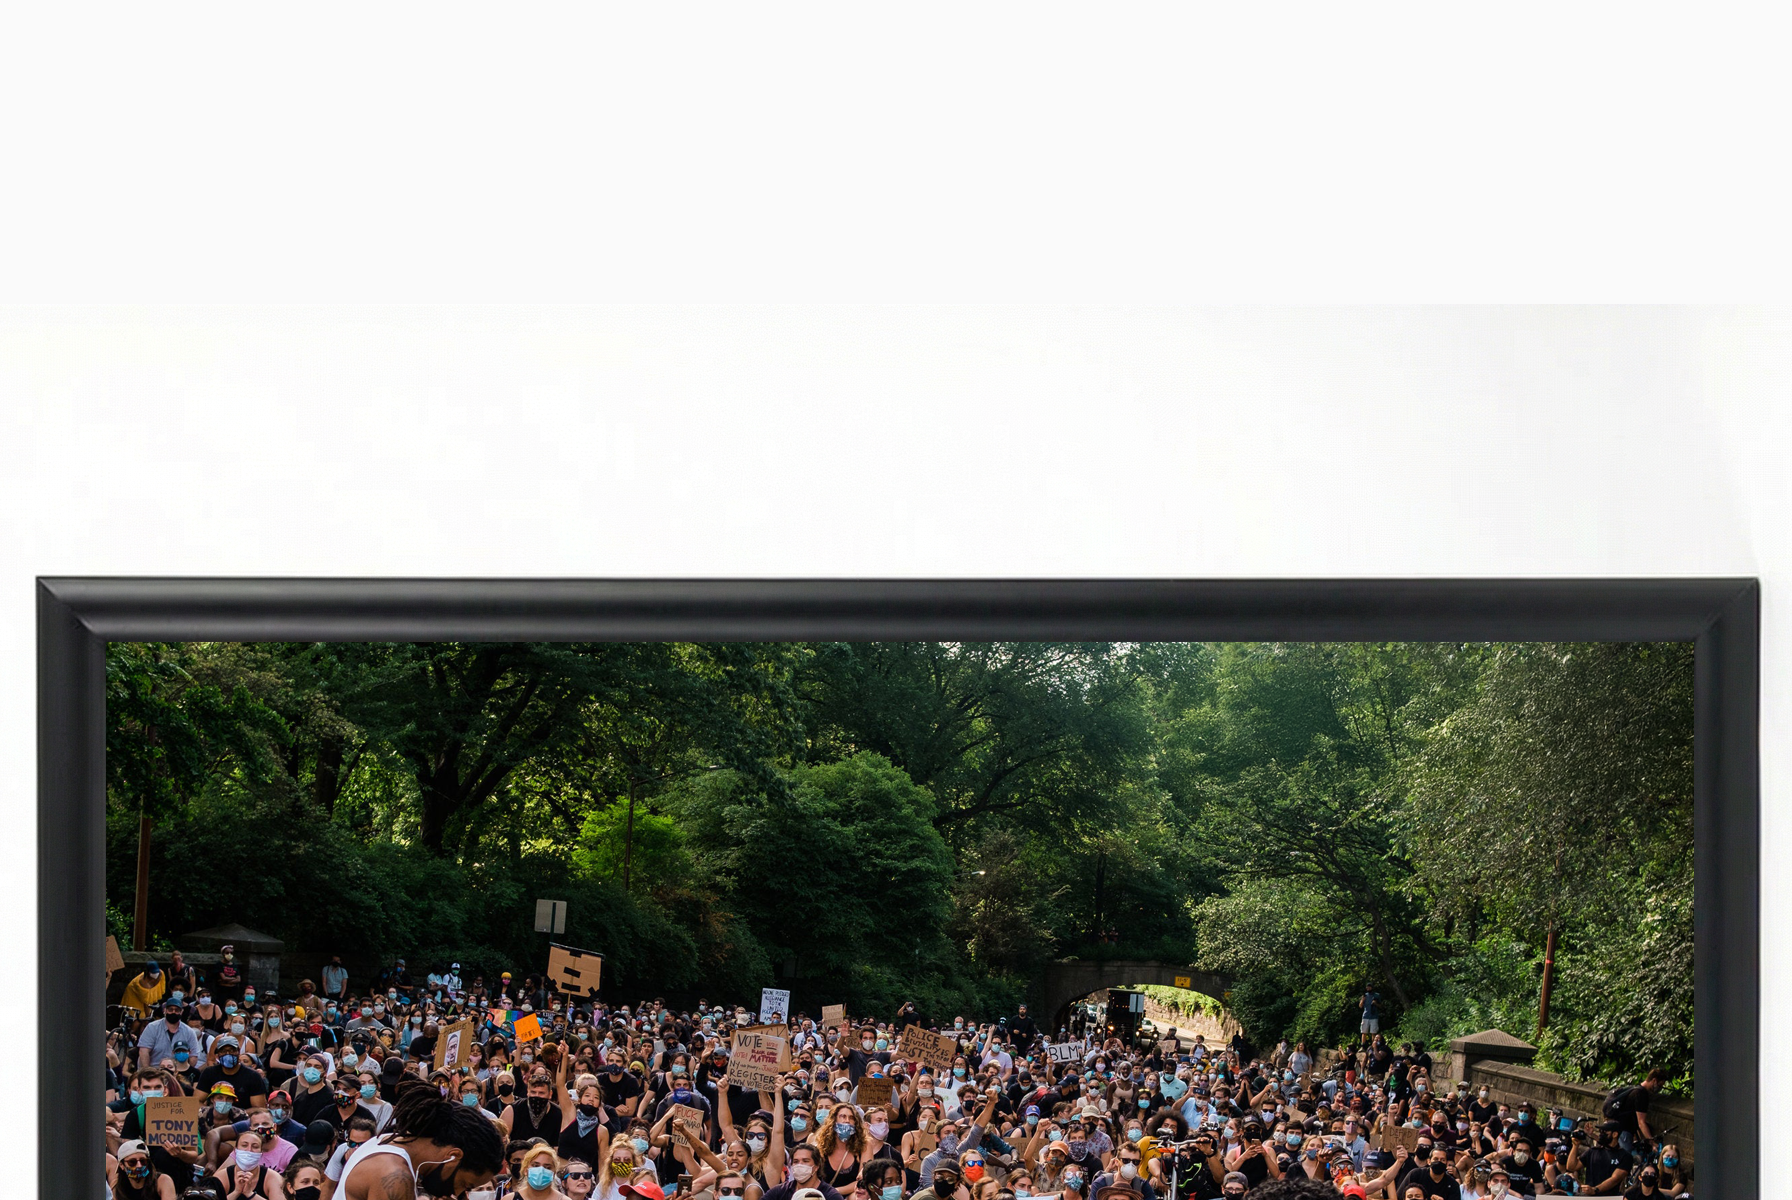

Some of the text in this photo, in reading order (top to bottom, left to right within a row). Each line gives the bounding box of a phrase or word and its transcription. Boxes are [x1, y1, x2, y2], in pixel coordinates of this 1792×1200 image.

[737, 1033, 763, 1049] VOTE
[907, 1028, 940, 1047] POLICE
[899, 1042, 925, 1057] JUST
[905, 1037, 940, 1054] BRUTALITY
[1049, 1045, 1079, 1061] BLM
[749, 1054, 777, 1064] MATTER
[730, 1068, 775, 1085] REGISTER
[152, 1101, 182, 1109] JUSTICE
[676, 1106, 698, 1120] FUCK
[151, 1119, 194, 1132] TONY
[148, 1132, 198, 1146] MCDADE
